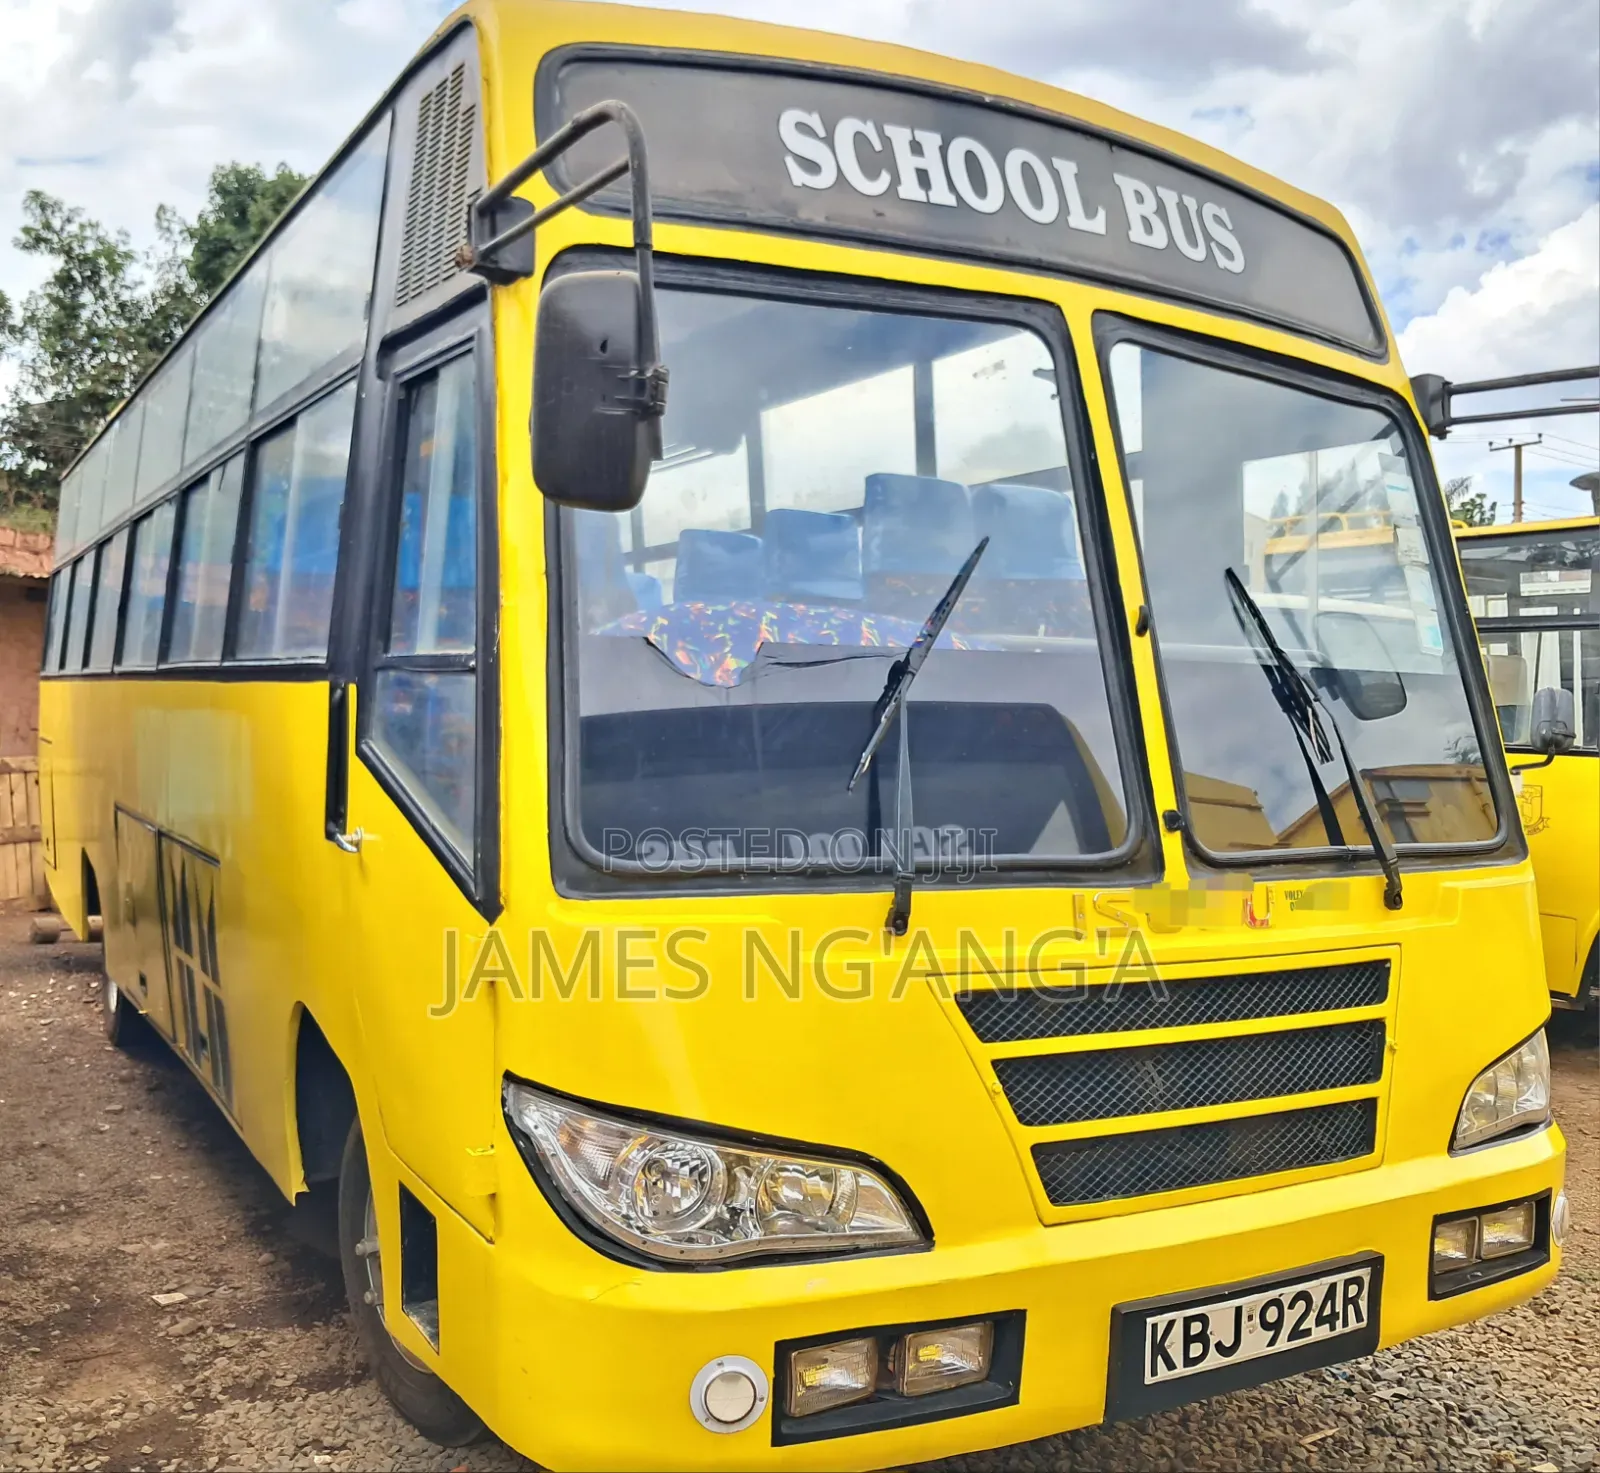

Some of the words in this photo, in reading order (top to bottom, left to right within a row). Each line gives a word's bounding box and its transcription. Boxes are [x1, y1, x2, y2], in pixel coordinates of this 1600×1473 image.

[778, 109, 1106, 235] SCHOOL
[1112, 172, 1245, 274] BUS
[1150, 1305, 1243, 1377] KBJ
[1259, 1276, 1366, 1348] 924R
